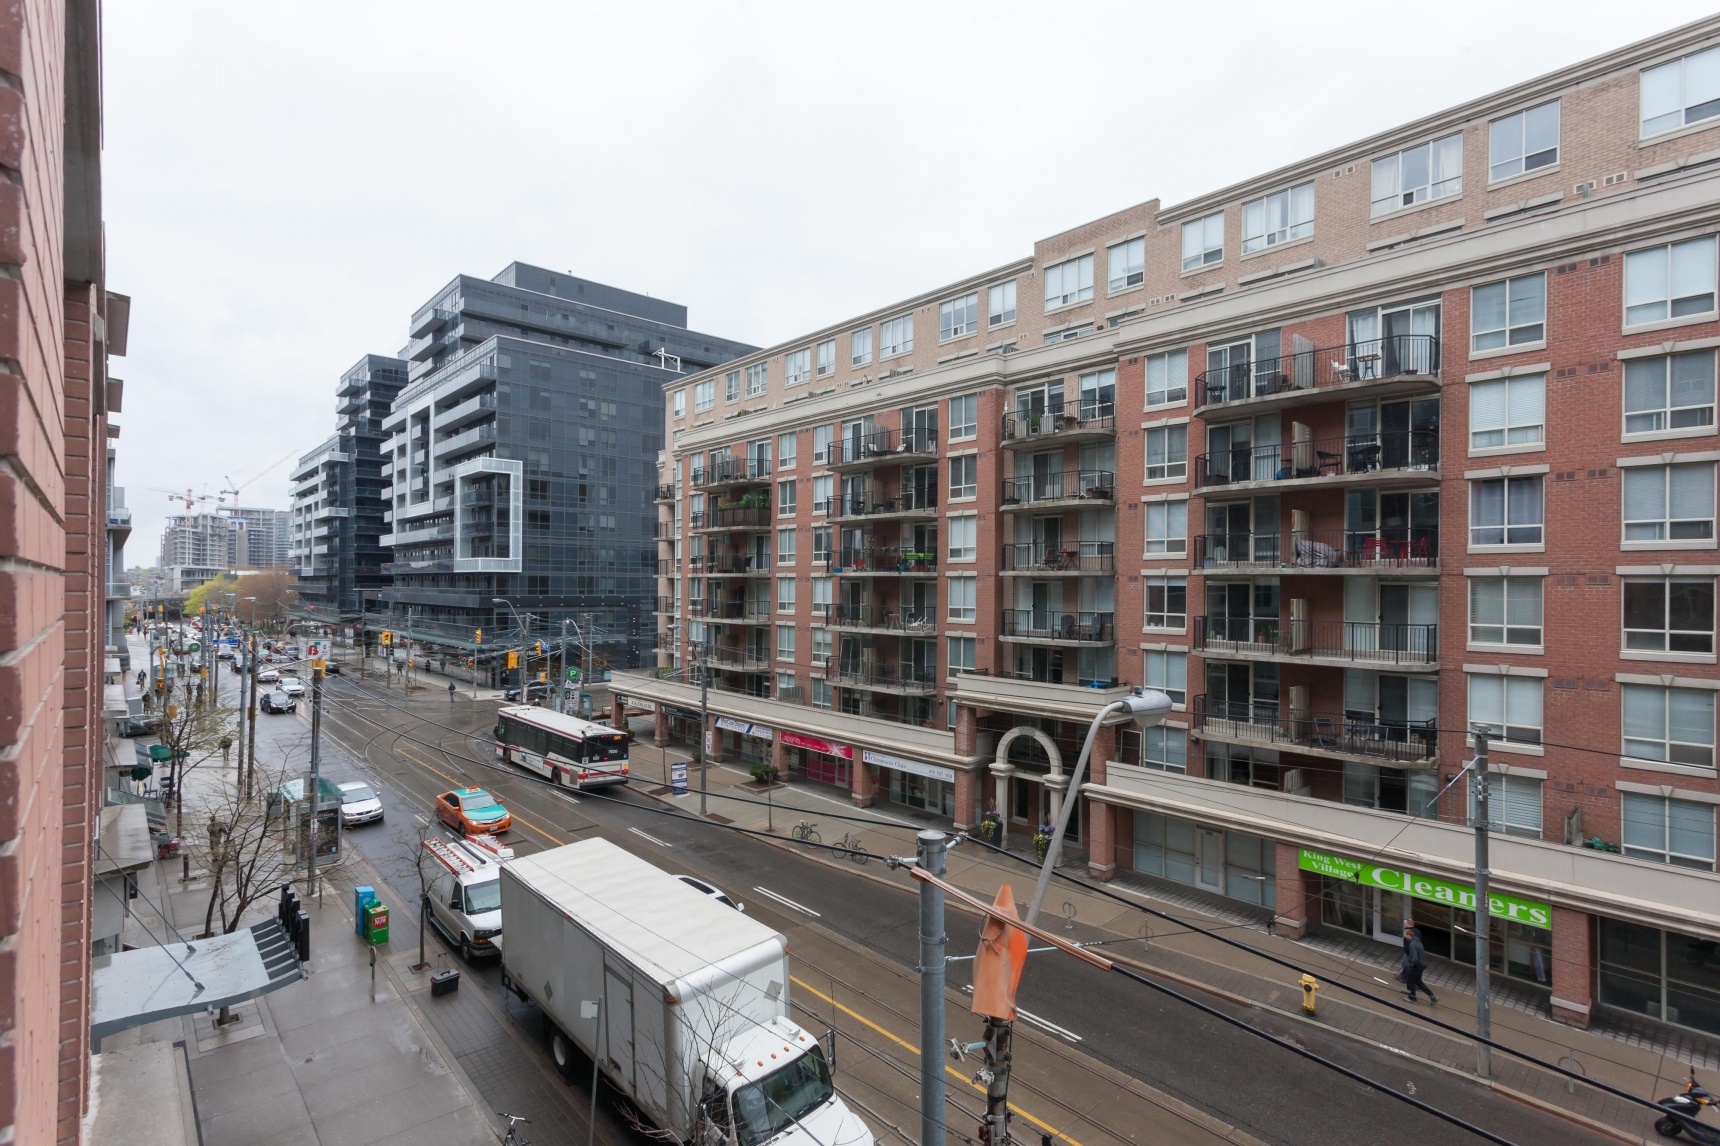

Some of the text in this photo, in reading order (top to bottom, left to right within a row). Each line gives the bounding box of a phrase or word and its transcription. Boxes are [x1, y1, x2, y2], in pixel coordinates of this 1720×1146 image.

[1303, 850, 1362, 870] King West
[1311, 861, 1354, 878] Village
[1371, 867, 1548, 924] Cleaners
